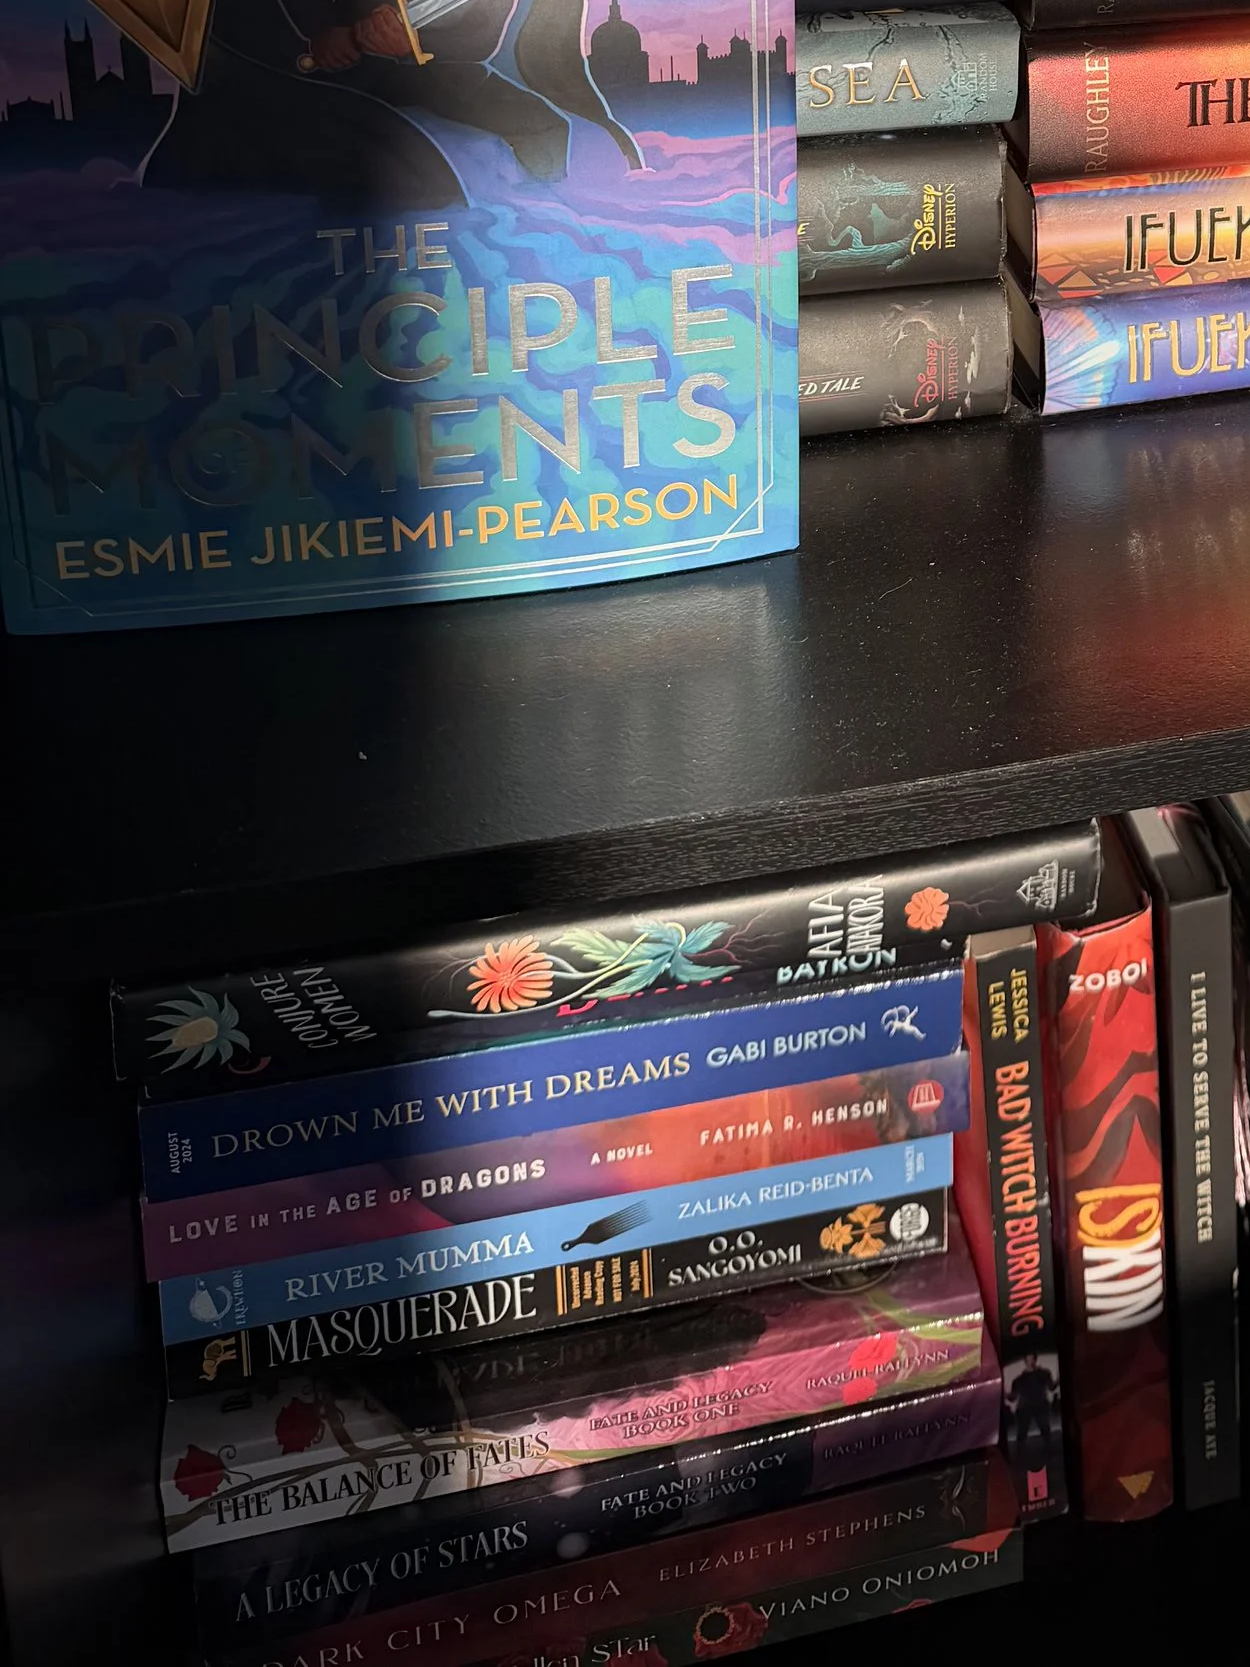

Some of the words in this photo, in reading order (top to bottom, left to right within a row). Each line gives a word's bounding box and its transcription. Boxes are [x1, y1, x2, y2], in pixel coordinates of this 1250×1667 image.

[808, 58, 927, 109] SEA
[1083, 41, 1111, 174] RAUGHLEY
[945, 182, 957, 249] HYPERION
[316, 222, 454, 276] THE
[821, 376, 864, 395] TALE
[56, 528, 233, 581] ESMIE
[249, 473, 739, 566] JIKIEMI-PEARSON
[1010, 967, 1030, 1044] JESSICA
[1068, 957, 1148, 994] ZOBOI
[988, 981, 1008, 1041] LEWIS
[212, 1111, 359, 1159] DROWN
[434, 1080, 533, 1119] WITH
[544, 1050, 691, 1100] DREAMS
[705, 1038, 767, 1068] GABI
[773, 1021, 867, 1055] BURTON
[995, 1059, 1032, 1123] BAD
[1193, 1070, 1210, 1134] SERVE
[168, 1132, 181, 1175] AUGUST
[168, 1213, 239, 1244] LOVE
[249, 1212, 271, 1230] IN
[279, 1203, 318, 1223] THE
[325, 1189, 379, 1216] AGE
[388, 1185, 413, 1205] OF
[420, 1157, 547, 1199] DRAGONS
[605, 1142, 655, 1163] NOVEL
[699, 1117, 774, 1147] FATIMA
[810, 1097, 889, 1128] HENSON
[181, 1138, 193, 1164] 2024
[1000, 1122, 1038, 1215] WITCH
[1194, 1136, 1211, 1177] THE
[284, 1258, 387, 1304] RIVER
[395, 1230, 535, 1280] MUMMA
[677, 1190, 754, 1221] ZALIKA
[757, 1166, 876, 1206] REID-BENTA
[667, 1242, 802, 1288] SANGOYOMI
[1004, 1214, 1045, 1337] BURNING
[266, 1271, 539, 1370] MASQUERADE
[694, 1401, 741, 1423] ONE
[280, 1457, 414, 1513] BALANCE
[467, 1430, 552, 1471] FATES
[436, 1519, 530, 1565] STARS
[492, 1578, 623, 1626] OMEGA
[659, 1536, 795, 1583] ELIZABETH
[805, 1504, 928, 1547] STEPHENS
[862, 1549, 1002, 1596] ONIOMOH
